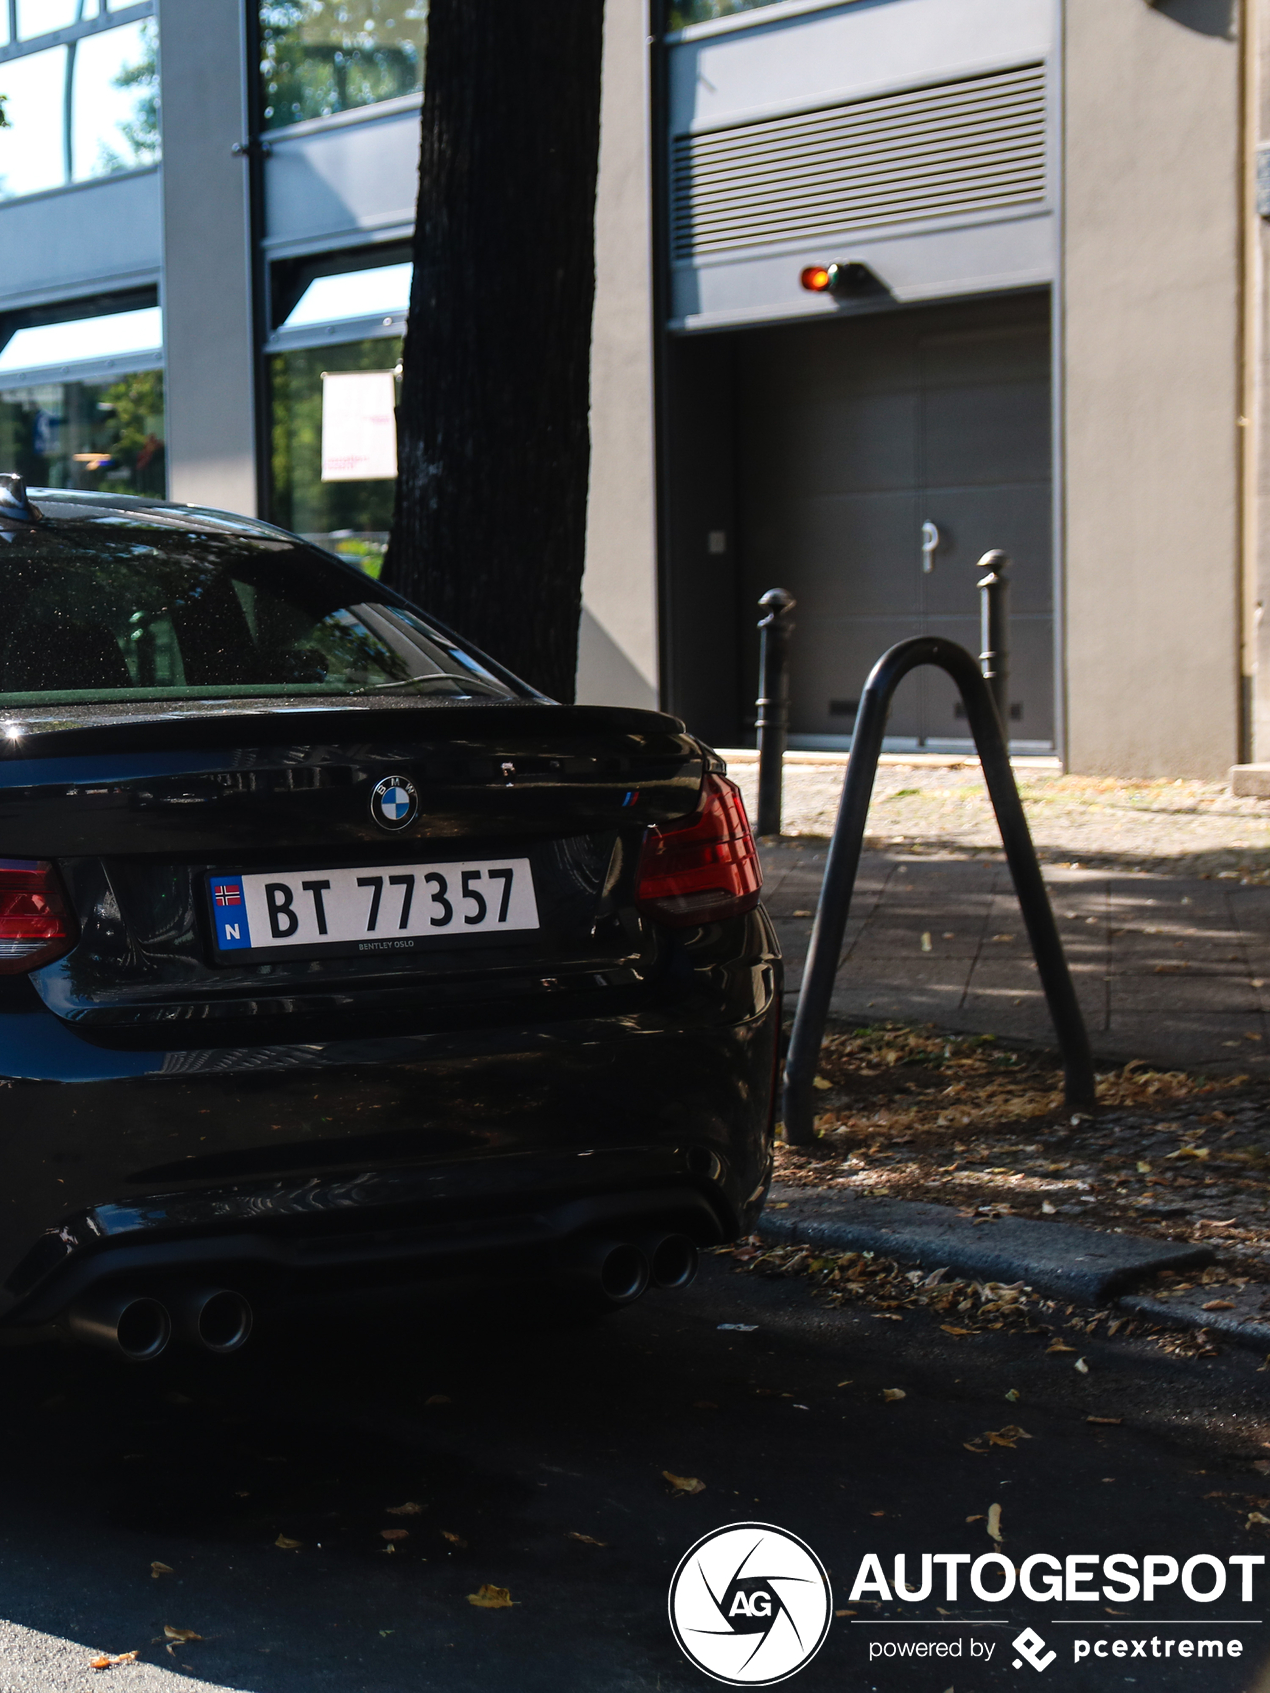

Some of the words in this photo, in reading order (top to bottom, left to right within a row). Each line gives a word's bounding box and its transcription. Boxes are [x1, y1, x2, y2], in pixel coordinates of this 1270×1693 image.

[376, 778, 415, 795] BMW
[264, 880, 330, 938] BT
[357, 869, 514, 931] 77357
[224, 923, 240, 940] N
[359, 941, 392, 951] BENTLEY
[394, 940, 414, 949] OSLO
